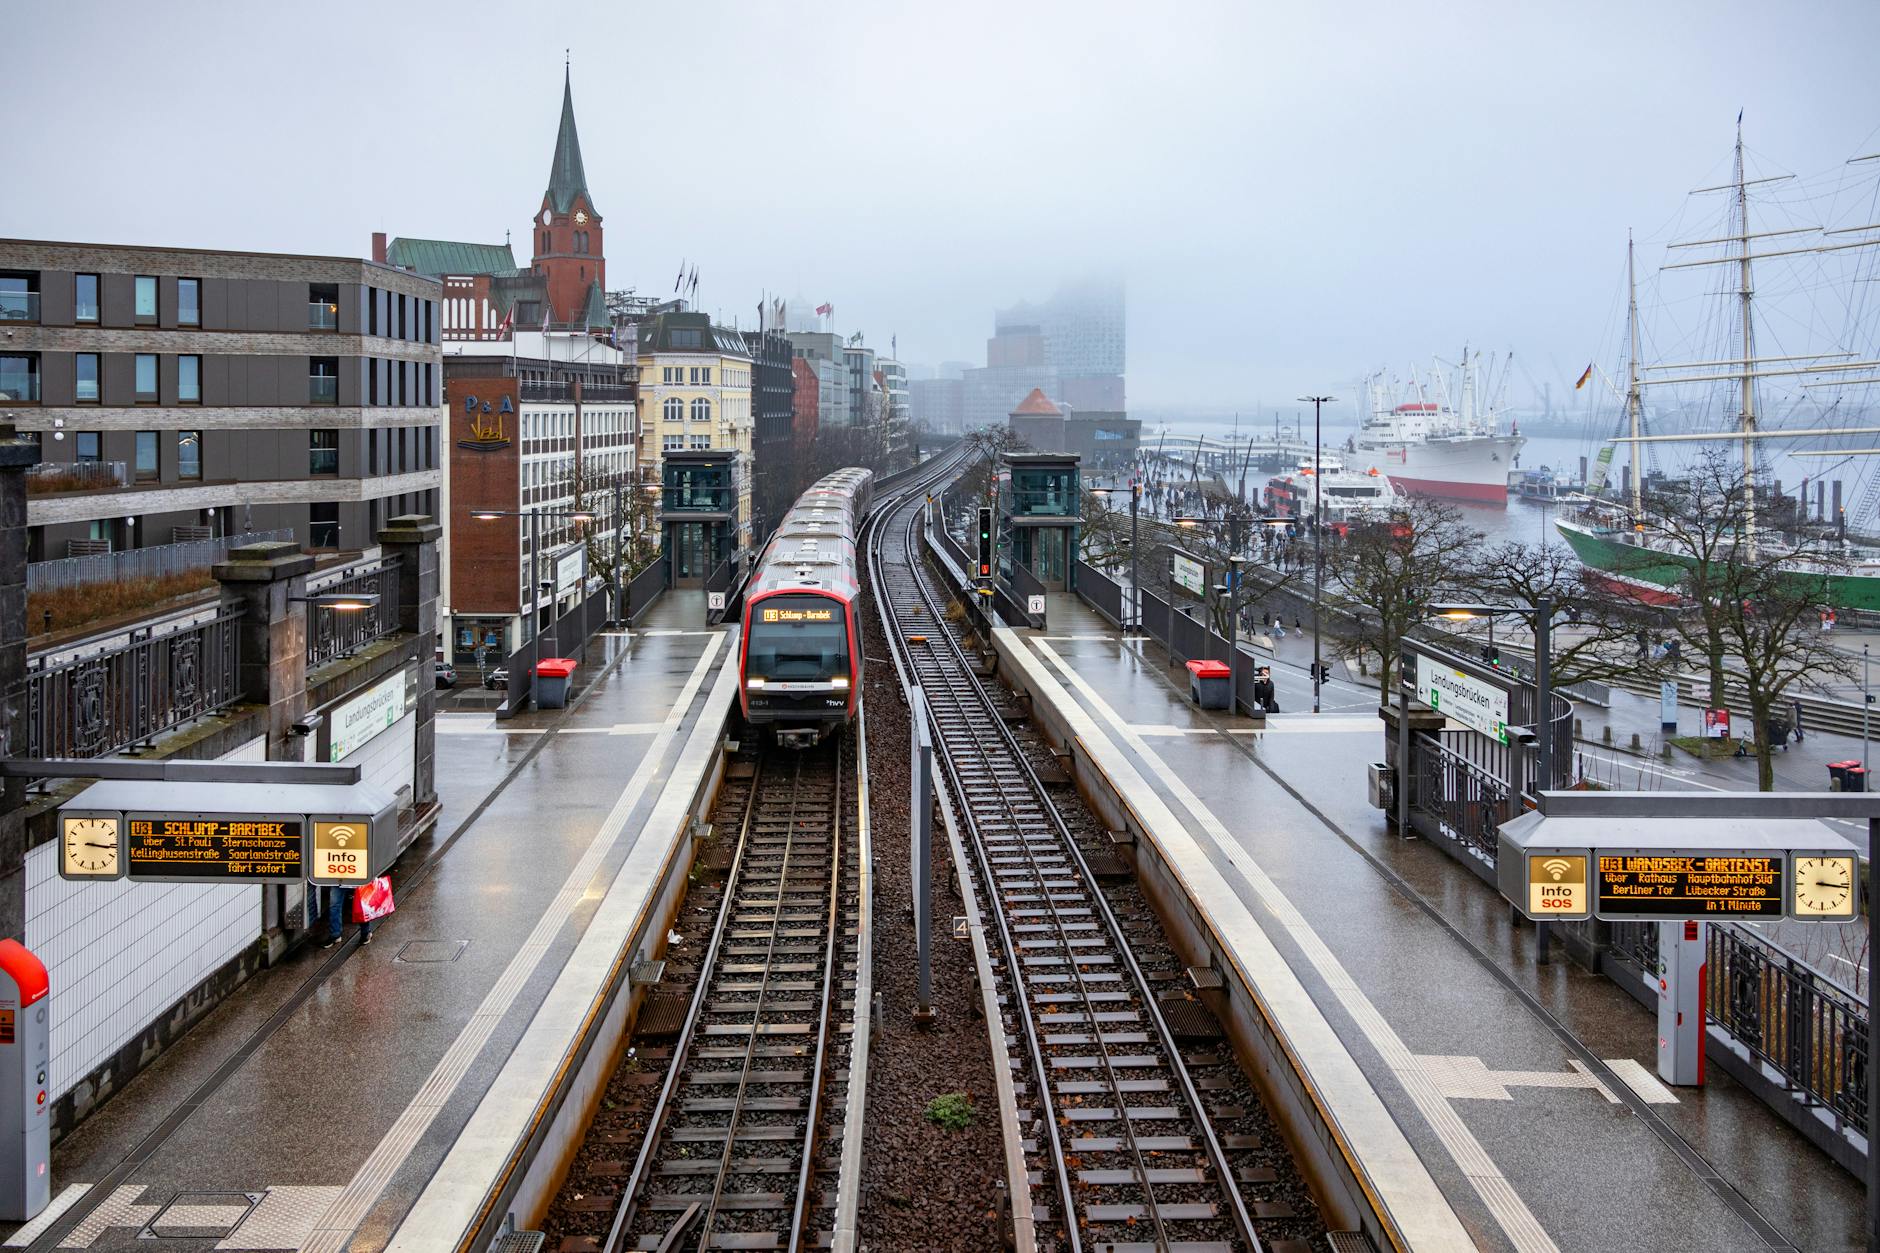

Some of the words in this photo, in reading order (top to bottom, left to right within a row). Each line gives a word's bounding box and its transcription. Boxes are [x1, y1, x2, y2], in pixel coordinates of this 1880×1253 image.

[465, 396, 478, 413] P
[482, 401, 492, 413] &
[500, 395, 513, 413] A
[1431, 669, 1490, 709] Landungsbrücken
[143, 836, 165, 846] über
[222, 837, 286, 848] Sternschanze
[131, 847, 220, 860] Kellinghusenstraße
[228, 848, 300, 861] Saarlandstraße
[327, 852, 356, 862] Info
[255, 863, 286, 874] sofort
[327, 864, 356, 874] SOS
[1638, 873, 1677, 884] Rathaus
[1688, 874, 1754, 886] Hauptbahnhof
[1755, 874, 1773, 885] Süd
[1541, 886, 1572, 897] Info
[1612, 885, 1655, 896] Berliner
[1657, 885, 1675, 896] Tor
[1685, 886, 1731, 897] Lübecker
[1732, 887, 1766, 898] Straße
[1541, 898, 1573, 909] SOS
[1720, 900, 1726, 911] 1
[1728, 901, 1762, 911] Minute
[955, 919, 968, 935] 4
